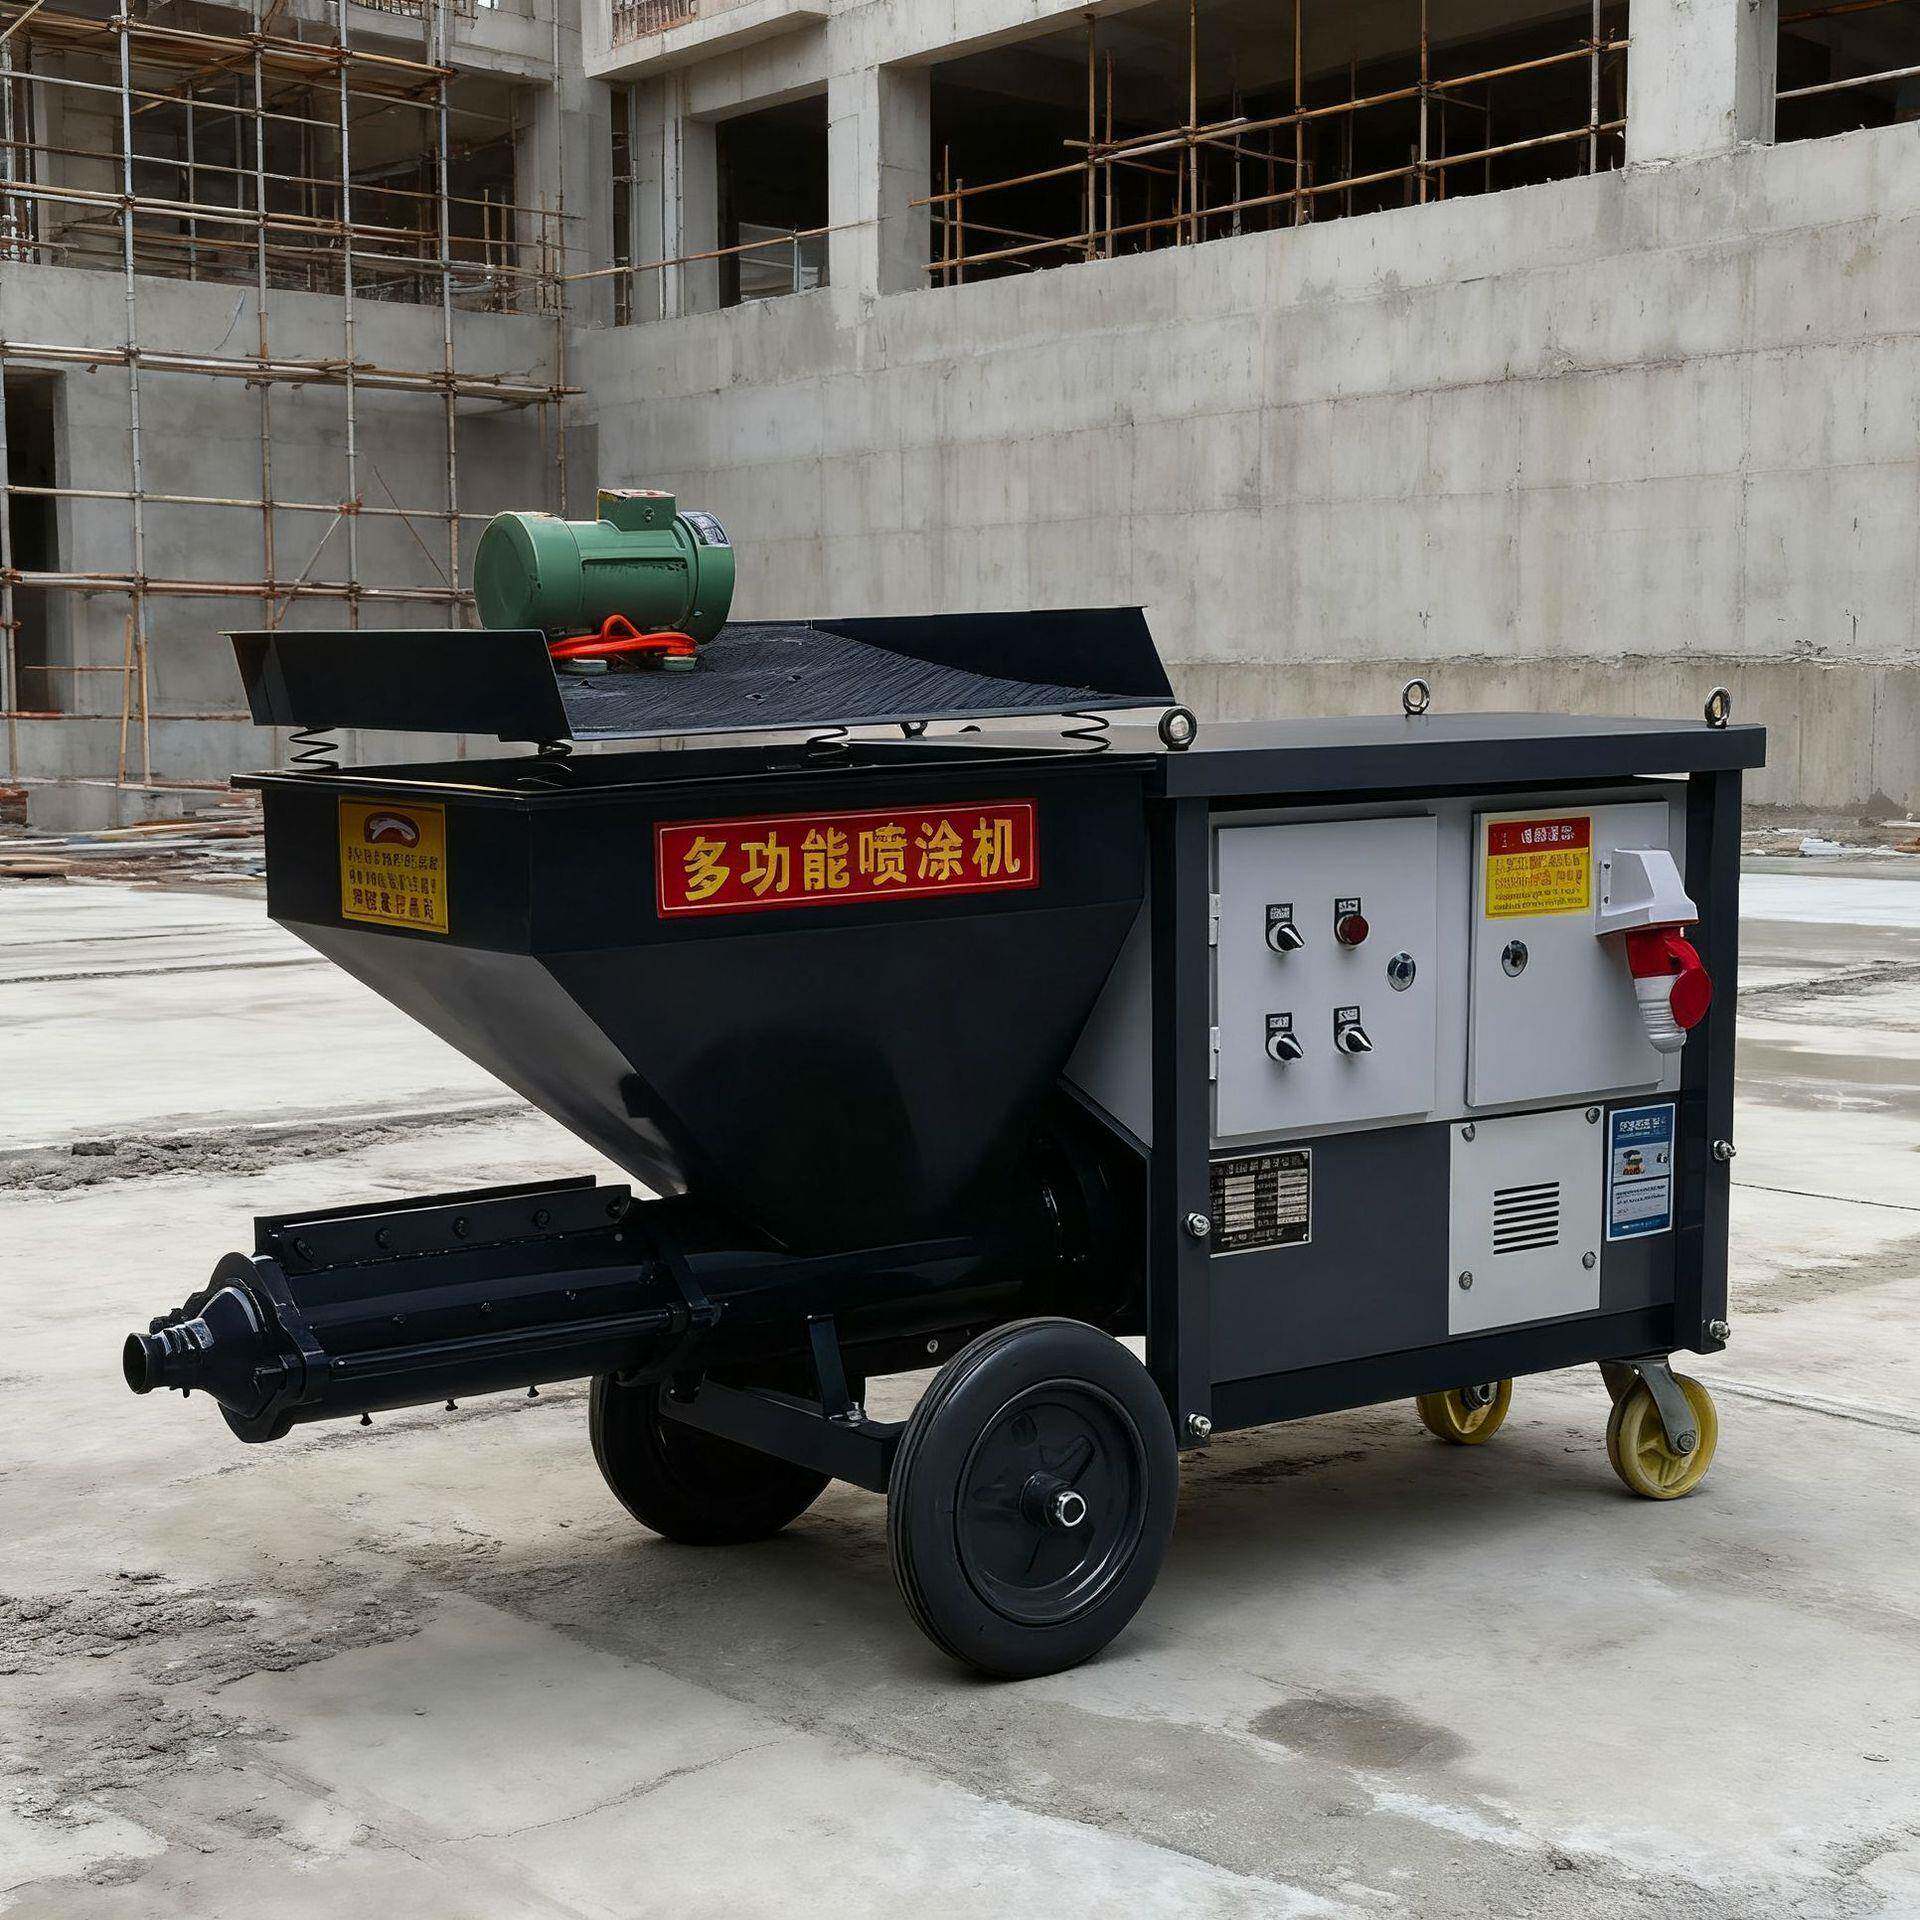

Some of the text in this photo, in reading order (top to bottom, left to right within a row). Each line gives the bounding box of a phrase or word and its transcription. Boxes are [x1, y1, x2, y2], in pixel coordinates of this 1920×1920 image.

[683, 817, 1020, 901] 多功能喷涂机
